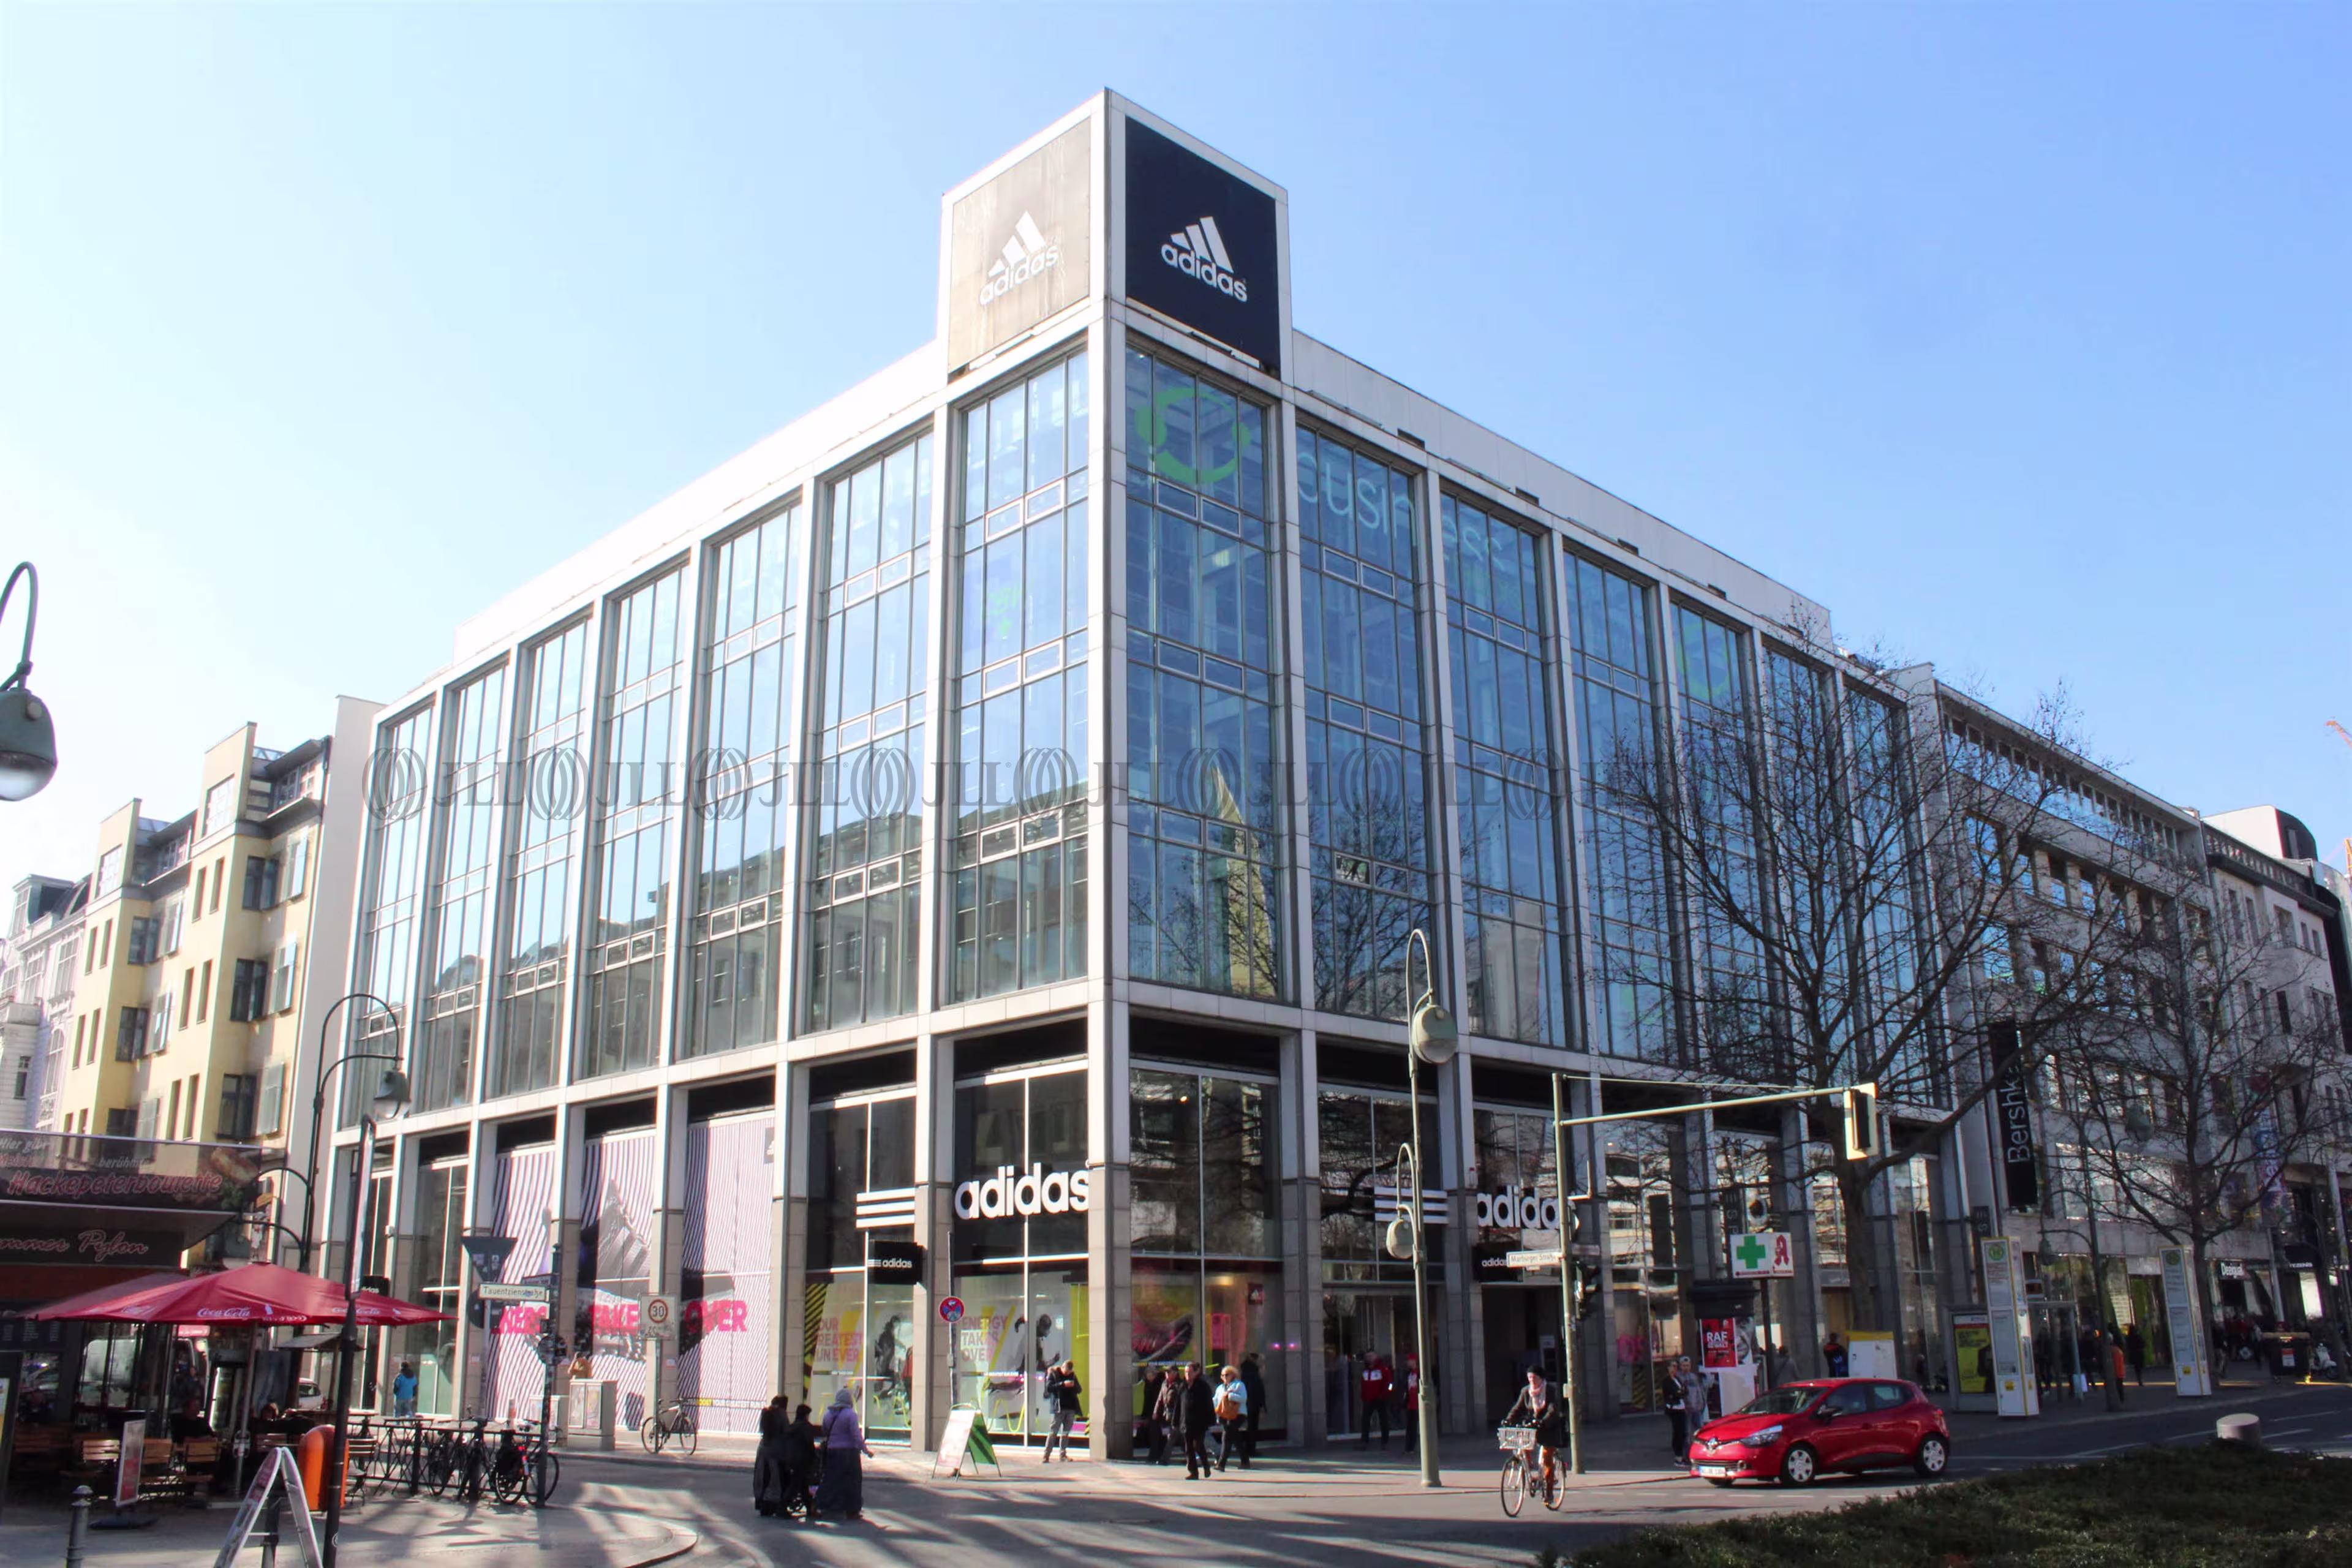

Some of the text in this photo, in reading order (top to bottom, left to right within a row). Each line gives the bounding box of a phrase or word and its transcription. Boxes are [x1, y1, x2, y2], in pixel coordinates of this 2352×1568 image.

[980, 243, 1059, 306] adidas
[1161, 243, 1248, 303] adidas
[7, 1170, 223, 1199] Hackepeterboulette
[954, 1161, 1088, 1220] adidas
[78, 1230, 148, 1262] Pylon
[882, 1257, 913, 1269] adidas
[483, 1286, 543, 1298] Tauentziensaße
[197, 1308, 251, 1317] Coca-Cola
[652, 1306, 665, 1317] 30
[684, 1300, 747, 1333] OVER
[817, 1317, 839, 1332] OUR
[961, 1315, 1008, 1331] ENERGY
[1706, 1331, 1727, 1342] RAF
